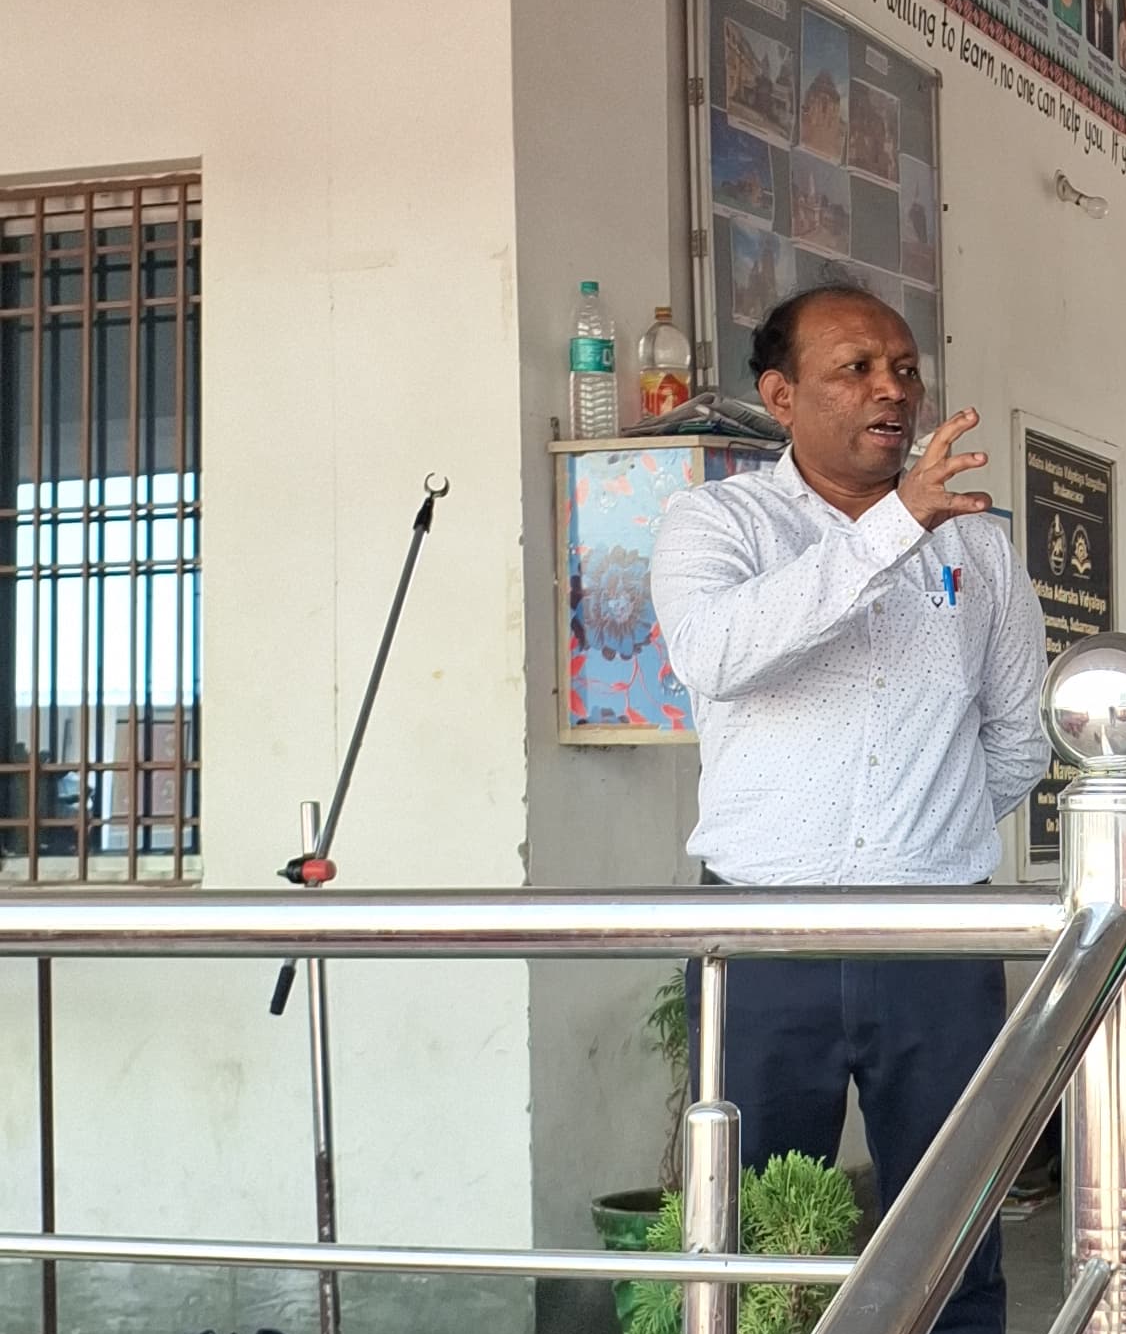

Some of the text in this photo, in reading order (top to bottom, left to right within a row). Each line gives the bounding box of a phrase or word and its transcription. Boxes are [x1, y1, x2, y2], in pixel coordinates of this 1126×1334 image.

[941, 7, 955, 52] to
[960, 20, 998, 86] learn,
[1000, 61, 1014, 91] no
[1016, 74, 1035, 106] one
[1037, 87, 1056, 120] can
[1059, 92, 1081, 144] help
[1084, 119, 1106, 155] you.
[1111, 130, 1119, 166] If
[1054, 584, 1079, 605] Adarsha
[1078, 589, 1107, 615] Vidyalaya
[1053, 759, 1081, 781] Navee
